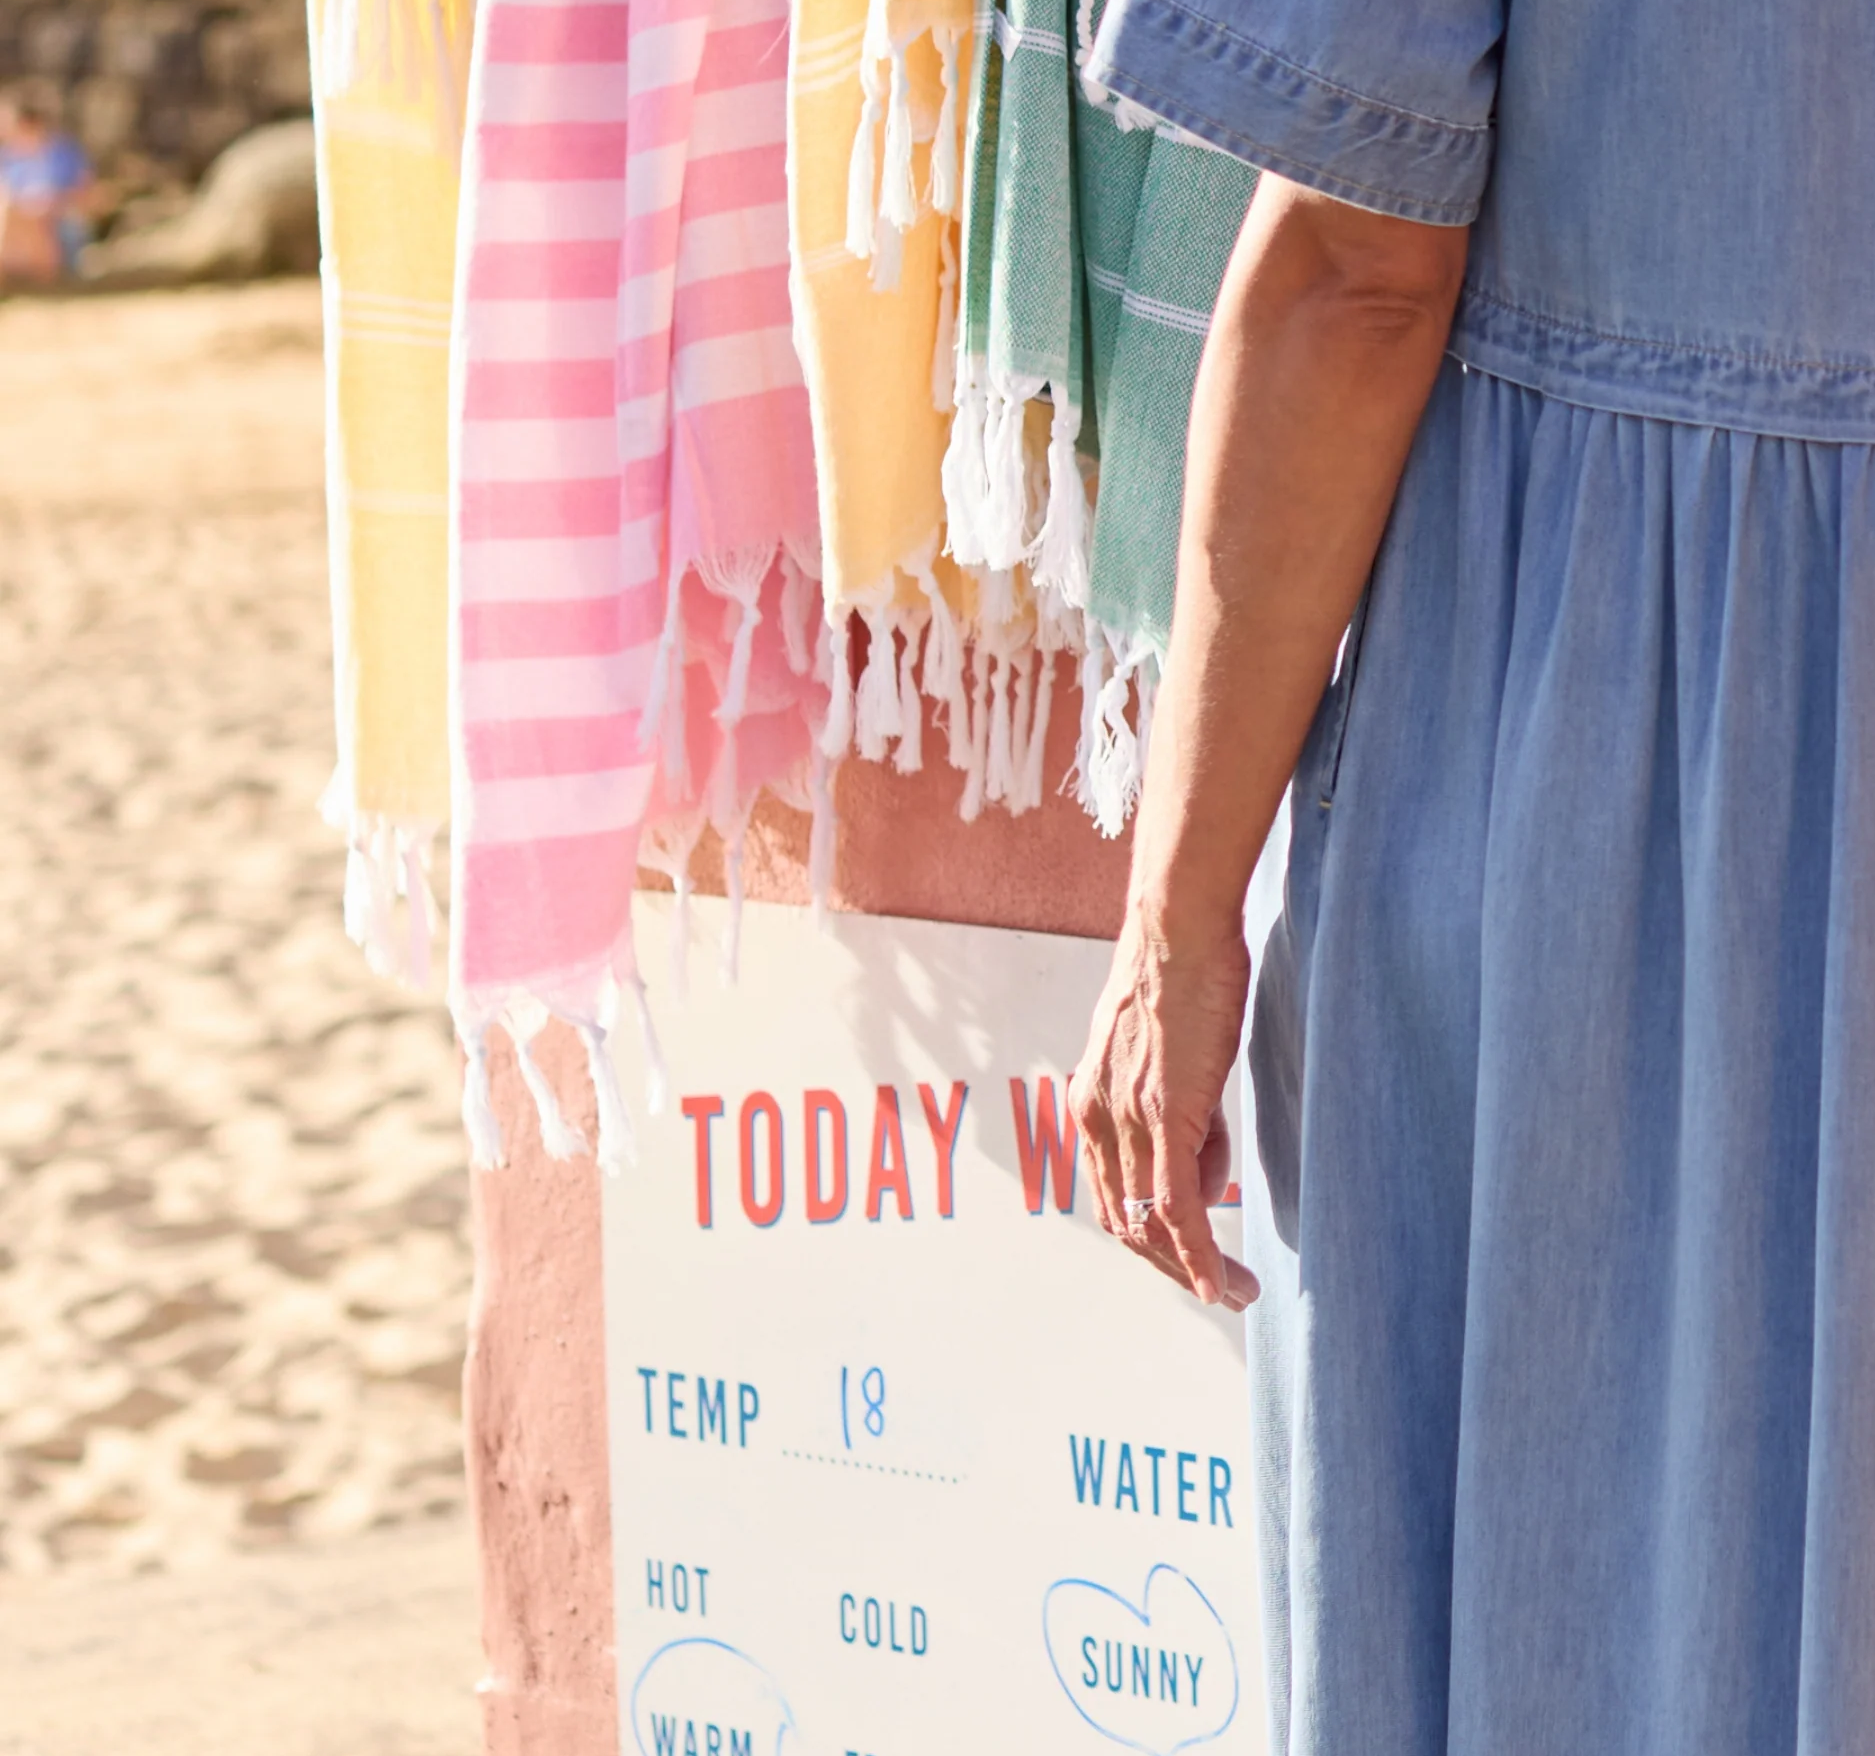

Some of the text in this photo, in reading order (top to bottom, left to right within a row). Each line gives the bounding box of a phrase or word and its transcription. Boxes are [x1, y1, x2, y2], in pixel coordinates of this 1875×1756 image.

[681, 1081, 969, 1229] TODAY
[636, 1367, 759, 1448] TEMP
[841, 1365, 886, 1449] 18
[1069, 1434, 1233, 1528] WATER
[646, 1558, 928, 1657] HOT COLD
[1082, 1636, 1204, 1708] SUNNY
